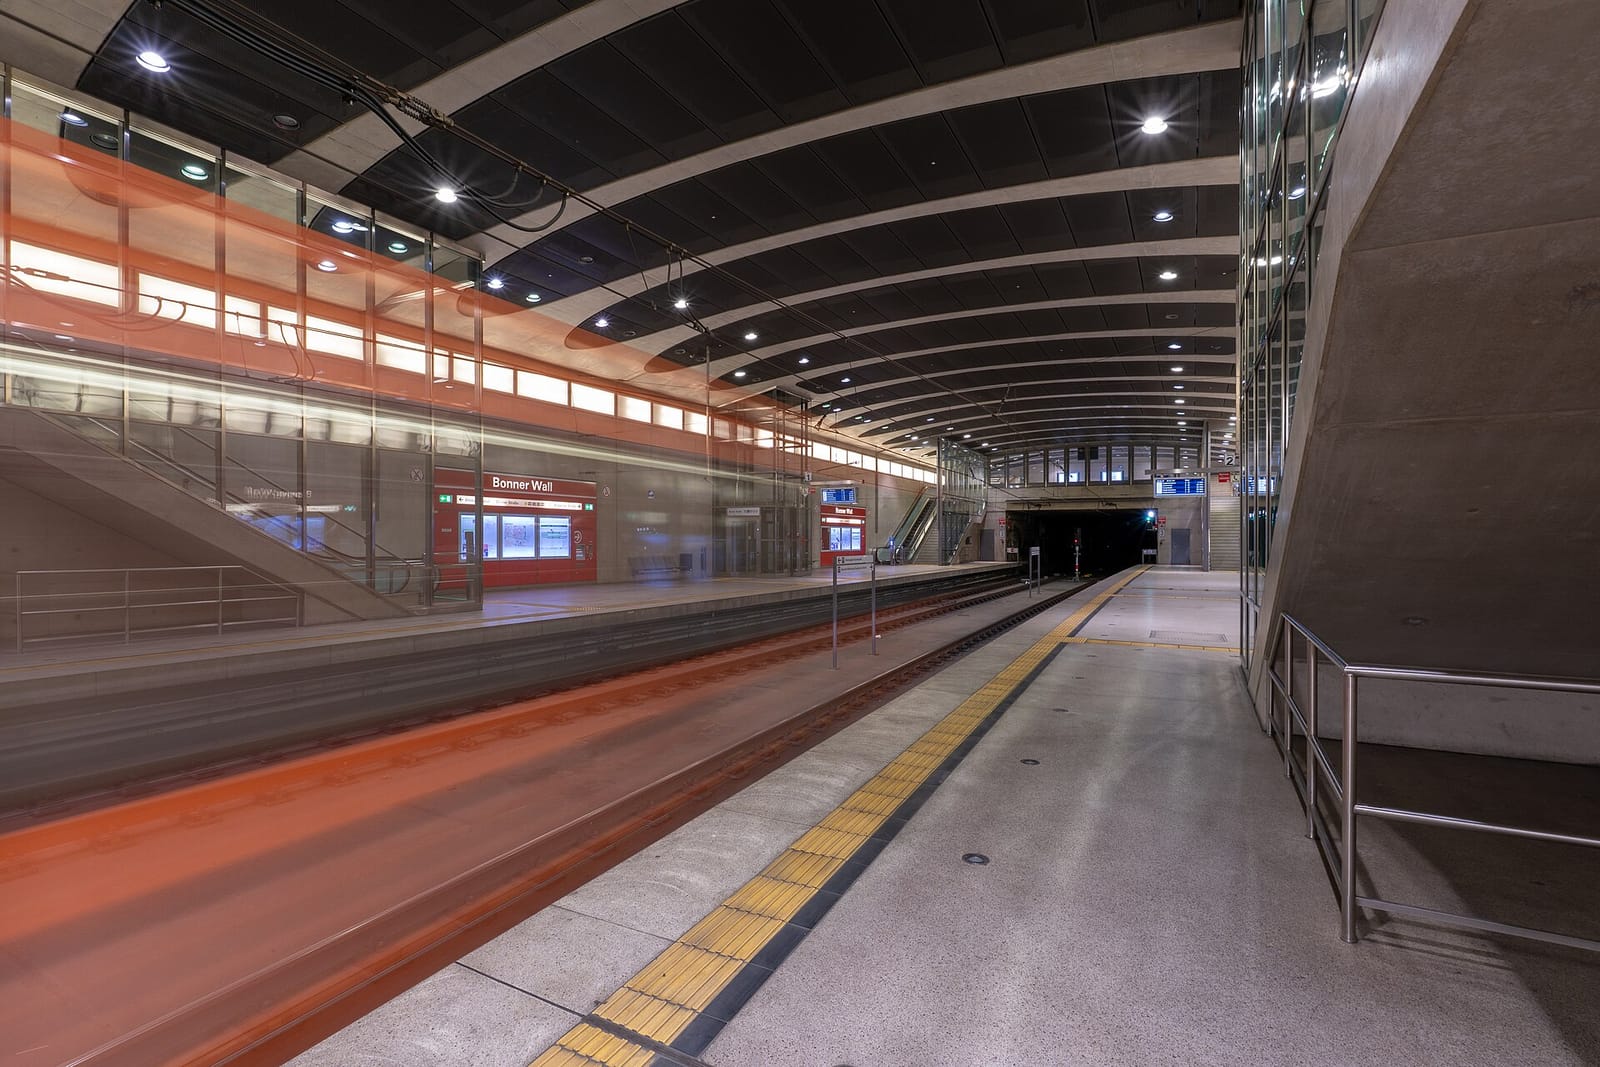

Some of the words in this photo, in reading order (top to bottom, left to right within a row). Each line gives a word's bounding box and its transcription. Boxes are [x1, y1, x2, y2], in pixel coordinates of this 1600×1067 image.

[1226, 457, 1233, 465] 2
[492, 476, 529, 490] Bonner
[531, 480, 553, 492] Wall
